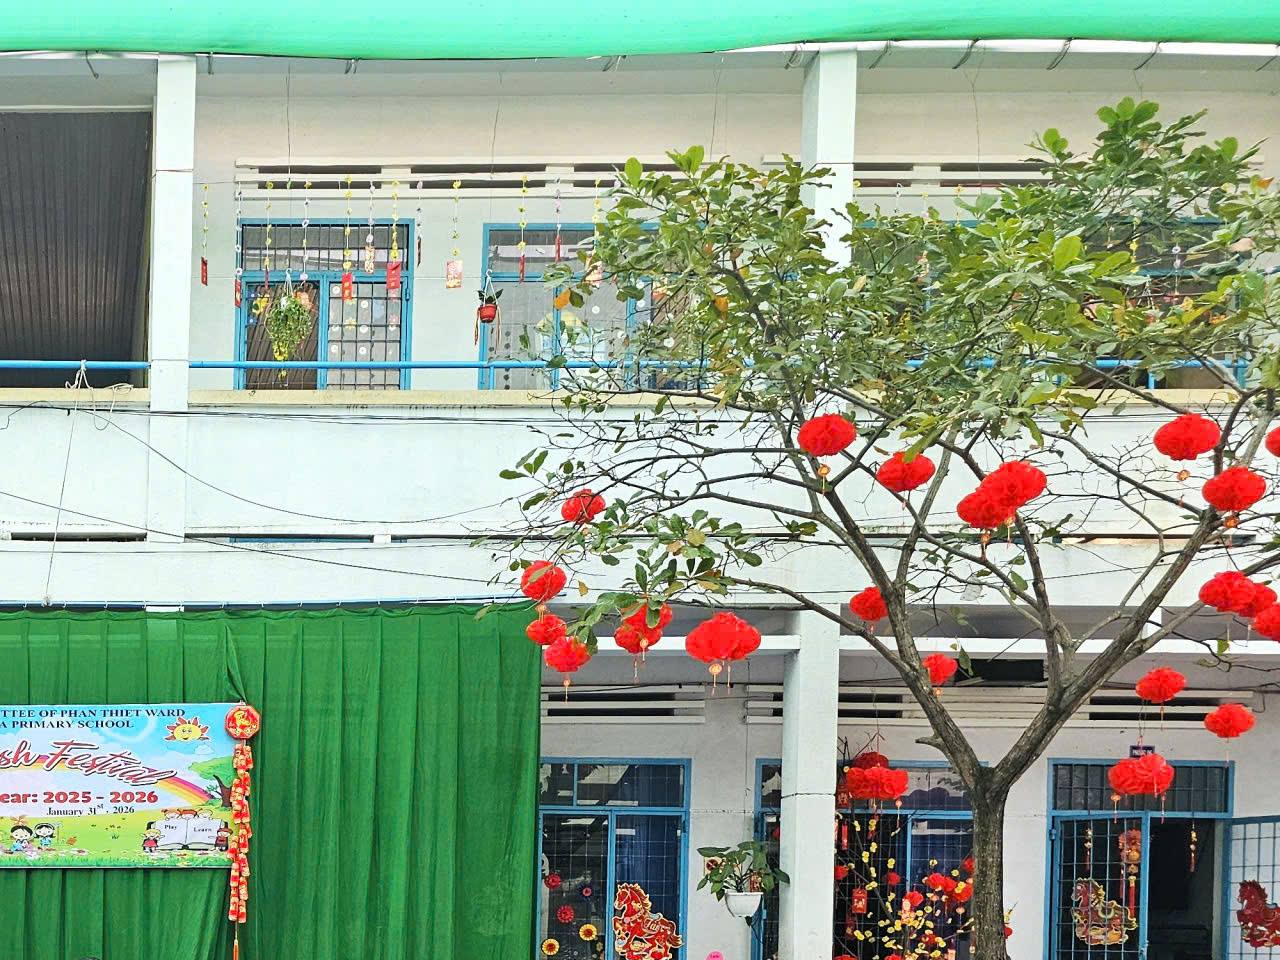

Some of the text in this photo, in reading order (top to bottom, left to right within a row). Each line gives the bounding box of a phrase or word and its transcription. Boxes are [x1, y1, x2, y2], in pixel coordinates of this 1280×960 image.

[39, 709, 57, 718] OF
[60, 709, 97, 718] PHAN
[100, 709, 141, 718] THIET
[145, 708, 185, 717] WARD
[11, 720, 74, 729] PRIMARY
[77, 719, 134, 728] SCHOOL
[43, 740, 176, 787] Festival
[43, 791, 92, 804] 2025
[109, 791, 159, 804] 2026
[46, 807, 86, 817] January
[113, 806, 135, 814] 2026
